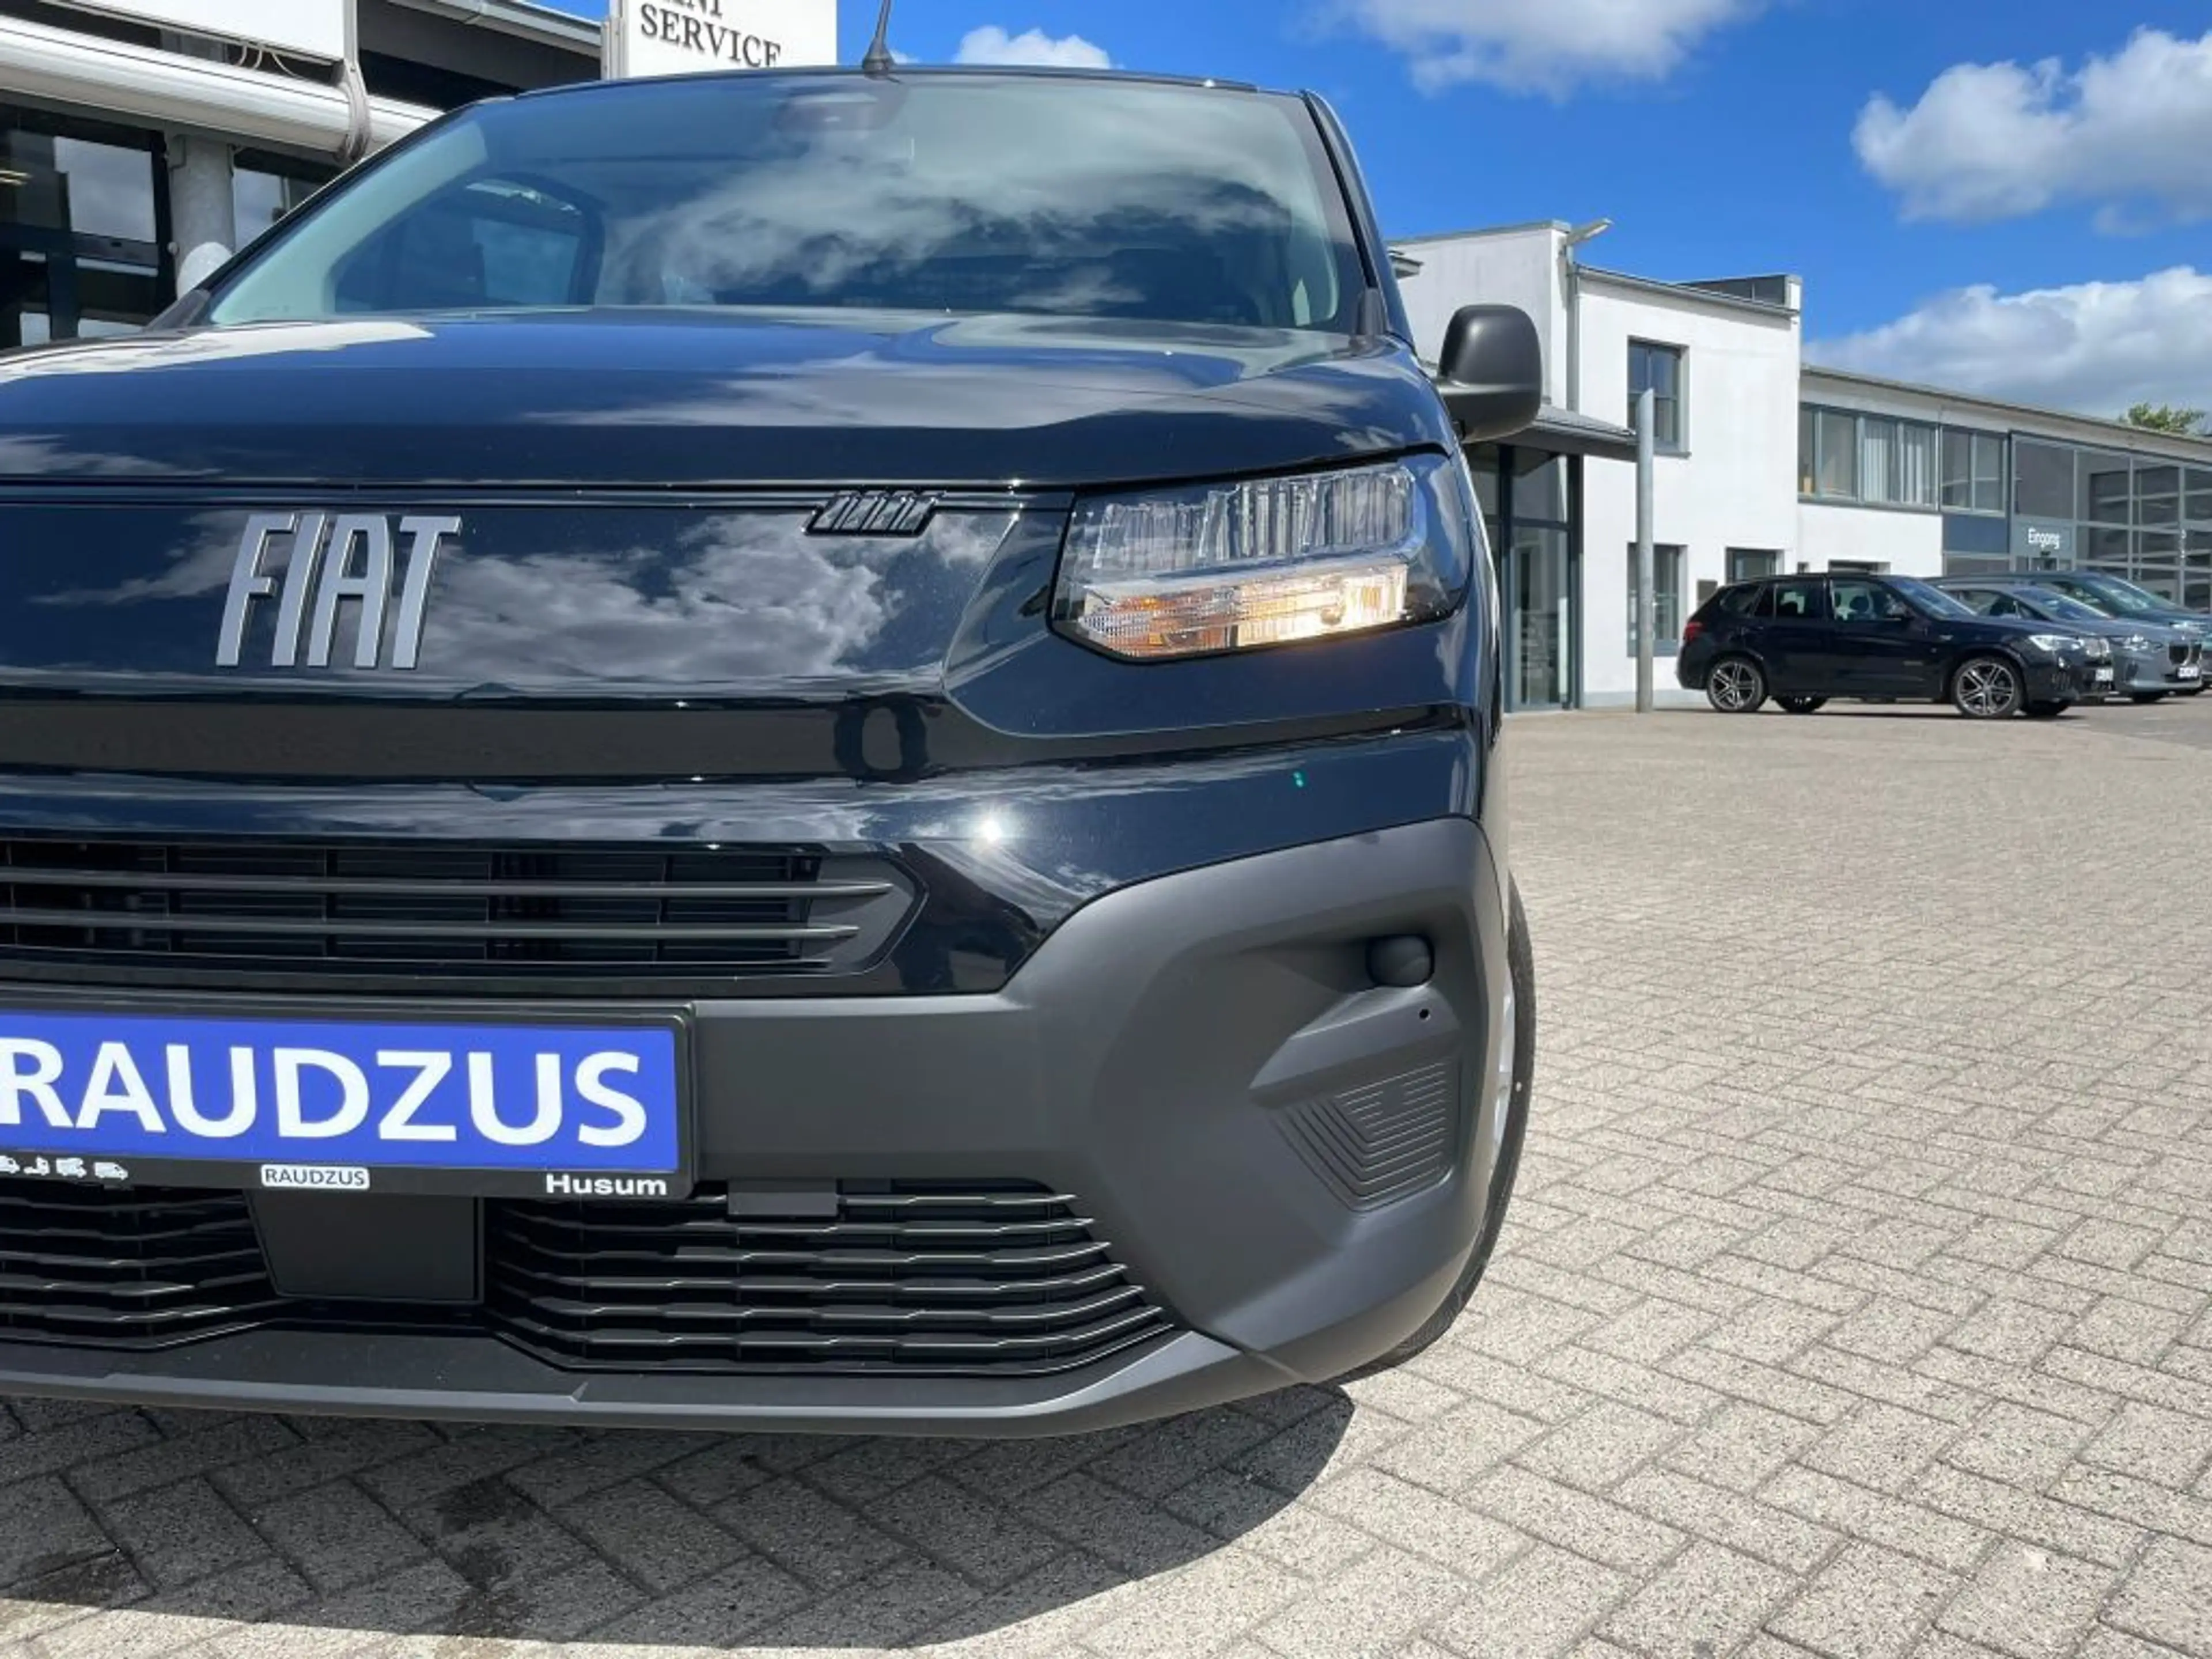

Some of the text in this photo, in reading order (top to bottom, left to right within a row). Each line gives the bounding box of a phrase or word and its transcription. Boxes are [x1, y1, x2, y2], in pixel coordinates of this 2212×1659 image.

[640, 3, 782, 67] SERVICE
[215, 513, 462, 670] FIAT
[0, 1037, 647, 1146] RAUDZUS
[265, 1168, 365, 1186] RAUDZUS
[546, 1173, 667, 1196] Husum
